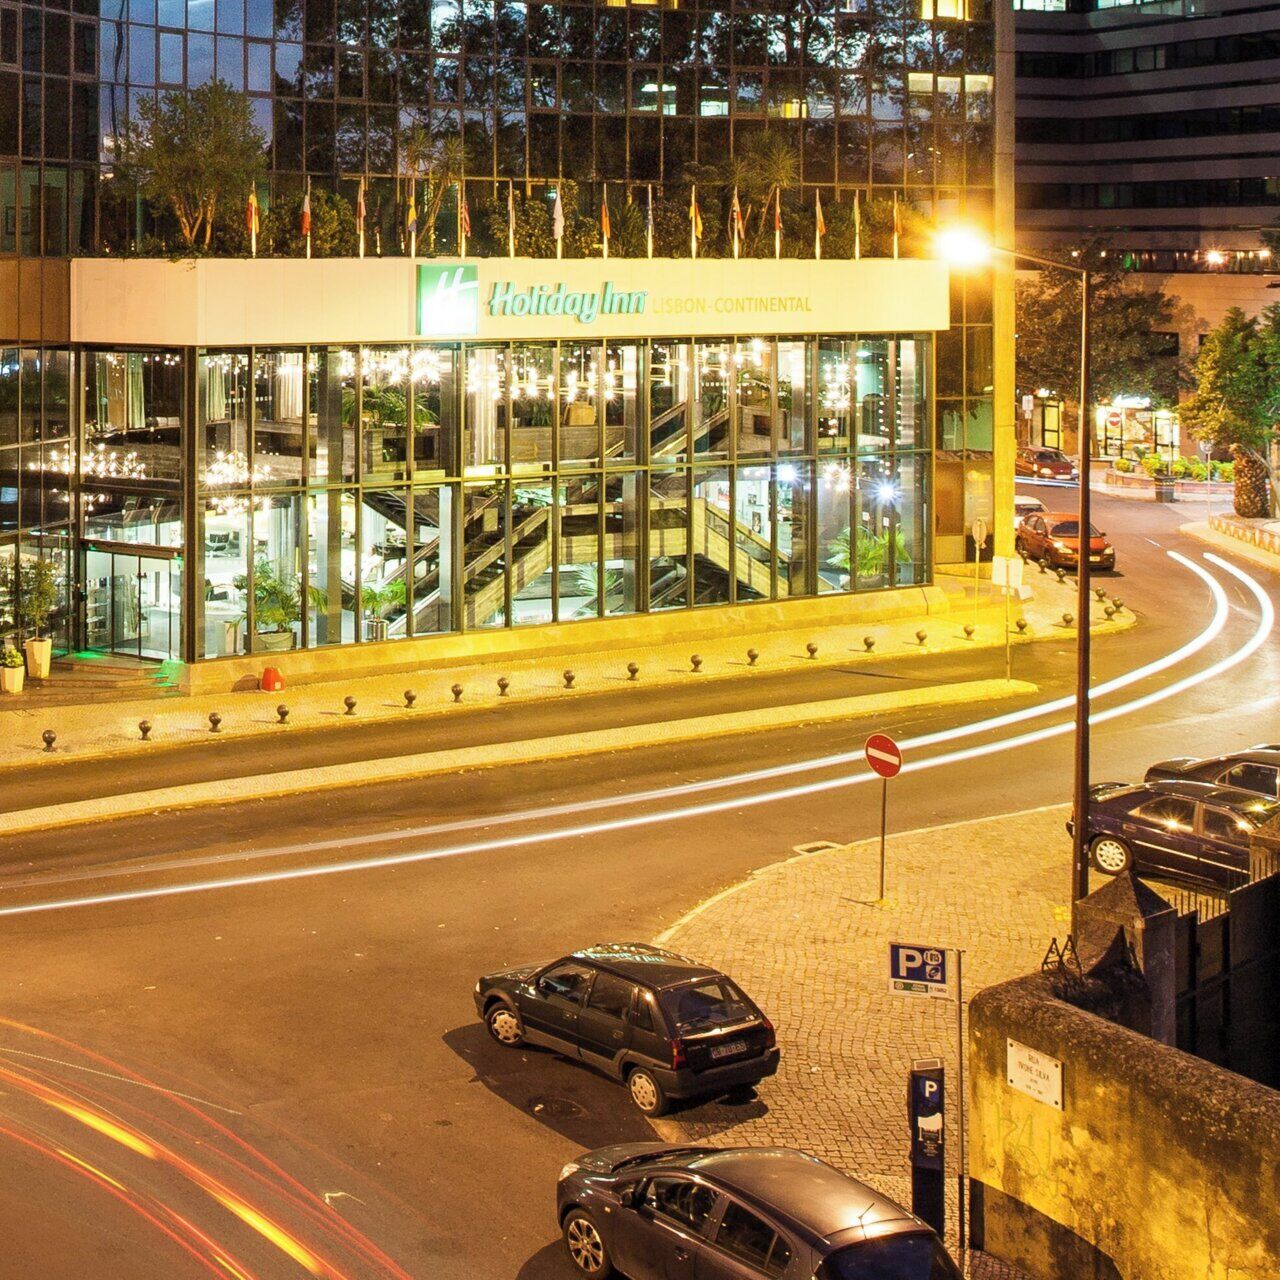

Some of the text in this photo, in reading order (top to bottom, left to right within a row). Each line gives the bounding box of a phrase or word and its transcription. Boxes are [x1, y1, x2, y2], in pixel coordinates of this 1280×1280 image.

[487, 281, 646, 324] Holiday Inn
[898, 948, 923, 977] P
[924, 1080, 938, 1098] P
